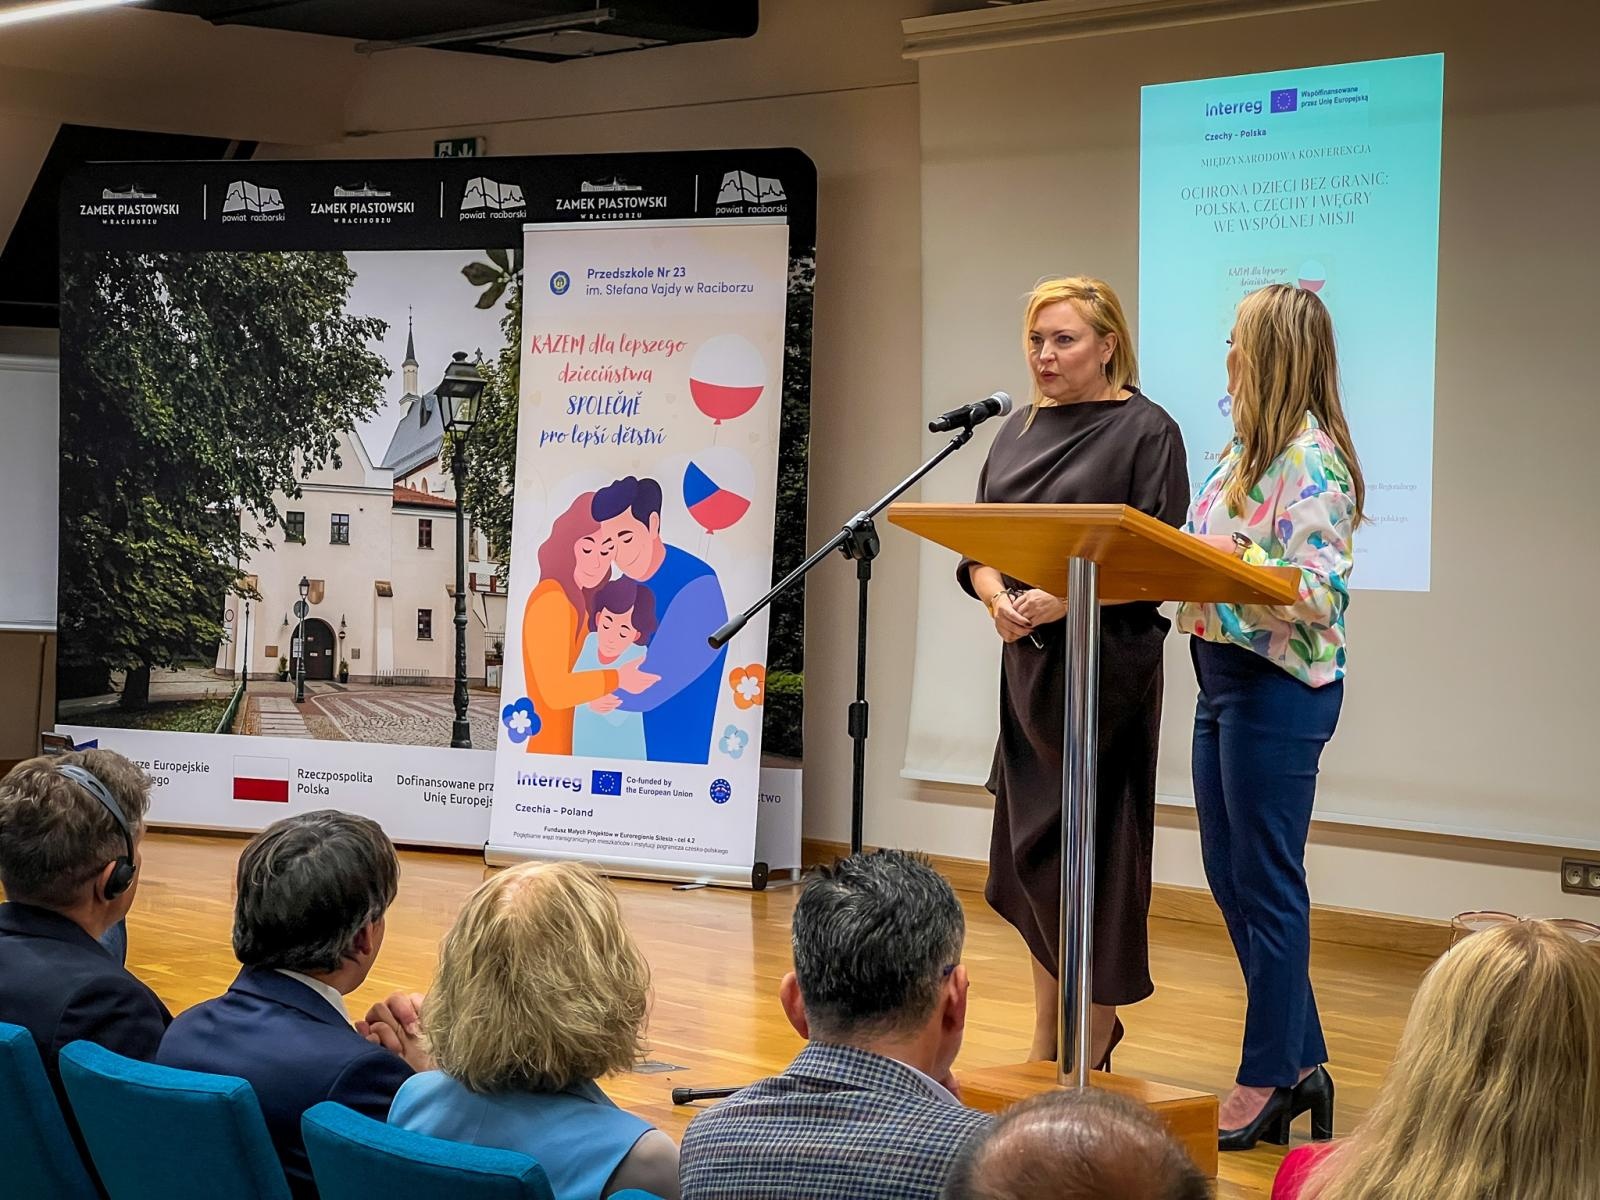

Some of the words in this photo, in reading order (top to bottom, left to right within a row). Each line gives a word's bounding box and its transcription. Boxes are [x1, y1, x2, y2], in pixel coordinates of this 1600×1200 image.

[1301, 100, 1318, 108] przez
[1334, 94, 1369, 104] Europejską
[1205, 100, 1263, 117] Interreg
[1205, 132, 1233, 141] Czechy
[1240, 128, 1267, 138] Polska
[1201, 151, 1296, 168] MIĘDZYNARODOWA
[1299, 144, 1371, 159] KONFERENCJA
[1181, 184, 1248, 200] OCHRONA
[1252, 179, 1297, 195] DZIECI
[1301, 176, 1326, 191] BEZ
[1330, 171, 1389, 188] GRANIC:
[80, 205, 115, 216] ZAMEK
[118, 203, 180, 215] PIASTOWSKI
[310, 202, 347, 214] ZAMEK
[350, 201, 415, 214] PIASTOWSKI
[556, 199, 595, 210] ZAMEK
[598, 196, 667, 209] PIASTOWSKI
[715, 205, 743, 215] powiat
[747, 204, 788, 214] raciborski
[1195, 201, 1250, 216] POLSKA,
[1253, 196, 1310, 212] CZECHY
[1319, 191, 1372, 208] WĘGRY
[222, 214, 247, 223] powiat
[250, 213, 286, 221] raciborski
[459, 212, 486, 221] powiat
[490, 211, 527, 219] raciborski
[1214, 220, 1235, 233] WE
[1239, 213, 1314, 231] WSPÓLNEJ
[1319, 210, 1355, 226] MISJI
[587, 266, 654, 280] Przedszkole
[657, 267, 670, 278] Nr
[673, 266, 686, 277] 23
[586, 284, 602, 296] im.
[606, 283, 648, 295] Stefana
[651, 281, 682, 297] Vajdy
[684, 284, 694, 293] w
[697, 281, 754, 294] Raciborzu
[588, 333, 615, 355] dla
[620, 332, 688, 358] lepszego
[558, 362, 653, 384] dzieciństwa
[566, 390, 644, 417] SPOLEČNĚ
[539, 429, 569, 448] pro
[571, 423, 609, 448] lepší
[611, 424, 668, 446] dětství
[153, 760, 210, 774] Europejskie
[297, 768, 373, 784] Rzeczpospolita
[517, 770, 583, 792] Interreg
[626, 776, 662, 787] Co-funded
[663, 779, 672, 788] by
[297, 784, 330, 796] Polska
[396, 775, 476, 791] Dofinansowane
[478, 782, 494, 793] prz
[626, 786, 636, 794] the
[638, 787, 672, 797] European
[672, 788, 693, 798] Union
[423, 792, 447, 805] Unię
[449, 793, 493, 809] Europejs
[515, 803, 551, 815] Czechia
[561, 806, 594, 817] Poland
[544, 825, 567, 834] Fundusz
[587, 830, 613, 838] Projektów
